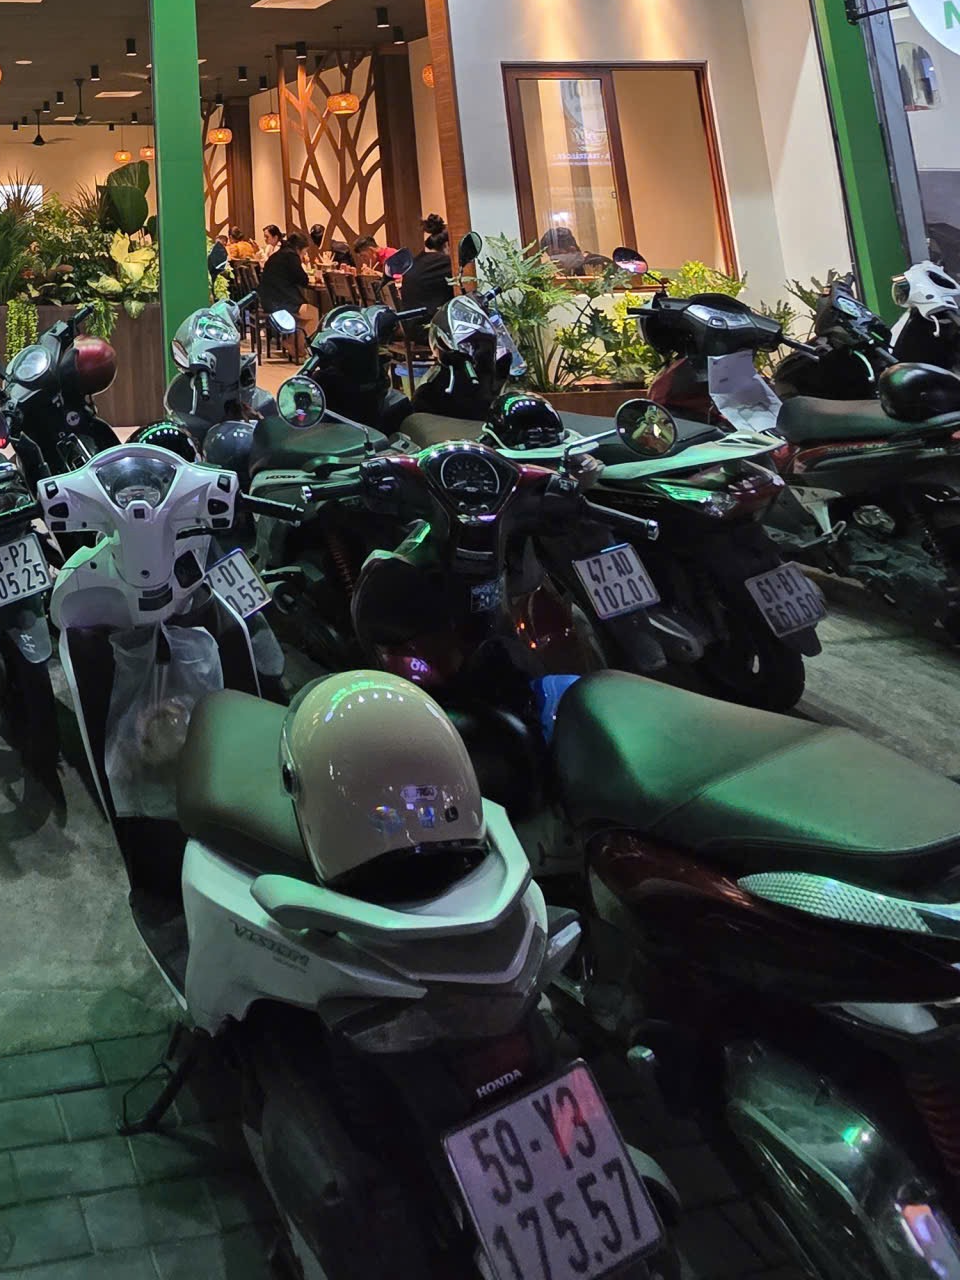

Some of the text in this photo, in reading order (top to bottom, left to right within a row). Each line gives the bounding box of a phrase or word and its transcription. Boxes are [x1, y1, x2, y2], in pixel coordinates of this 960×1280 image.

[204, 559, 244, 589] 7-D1
[586, 551, 634, 585] 47-AD
[224, 578, 266, 616] 0.55
[593, 575, 653, 613] 102.01
[756, 569, 802, 604] 61-B1
[476, 1068, 523, 1099] HONDA
[470, 1085, 597, 1206] 59-Y3
[493, 1156, 641, 1280] 175.57
